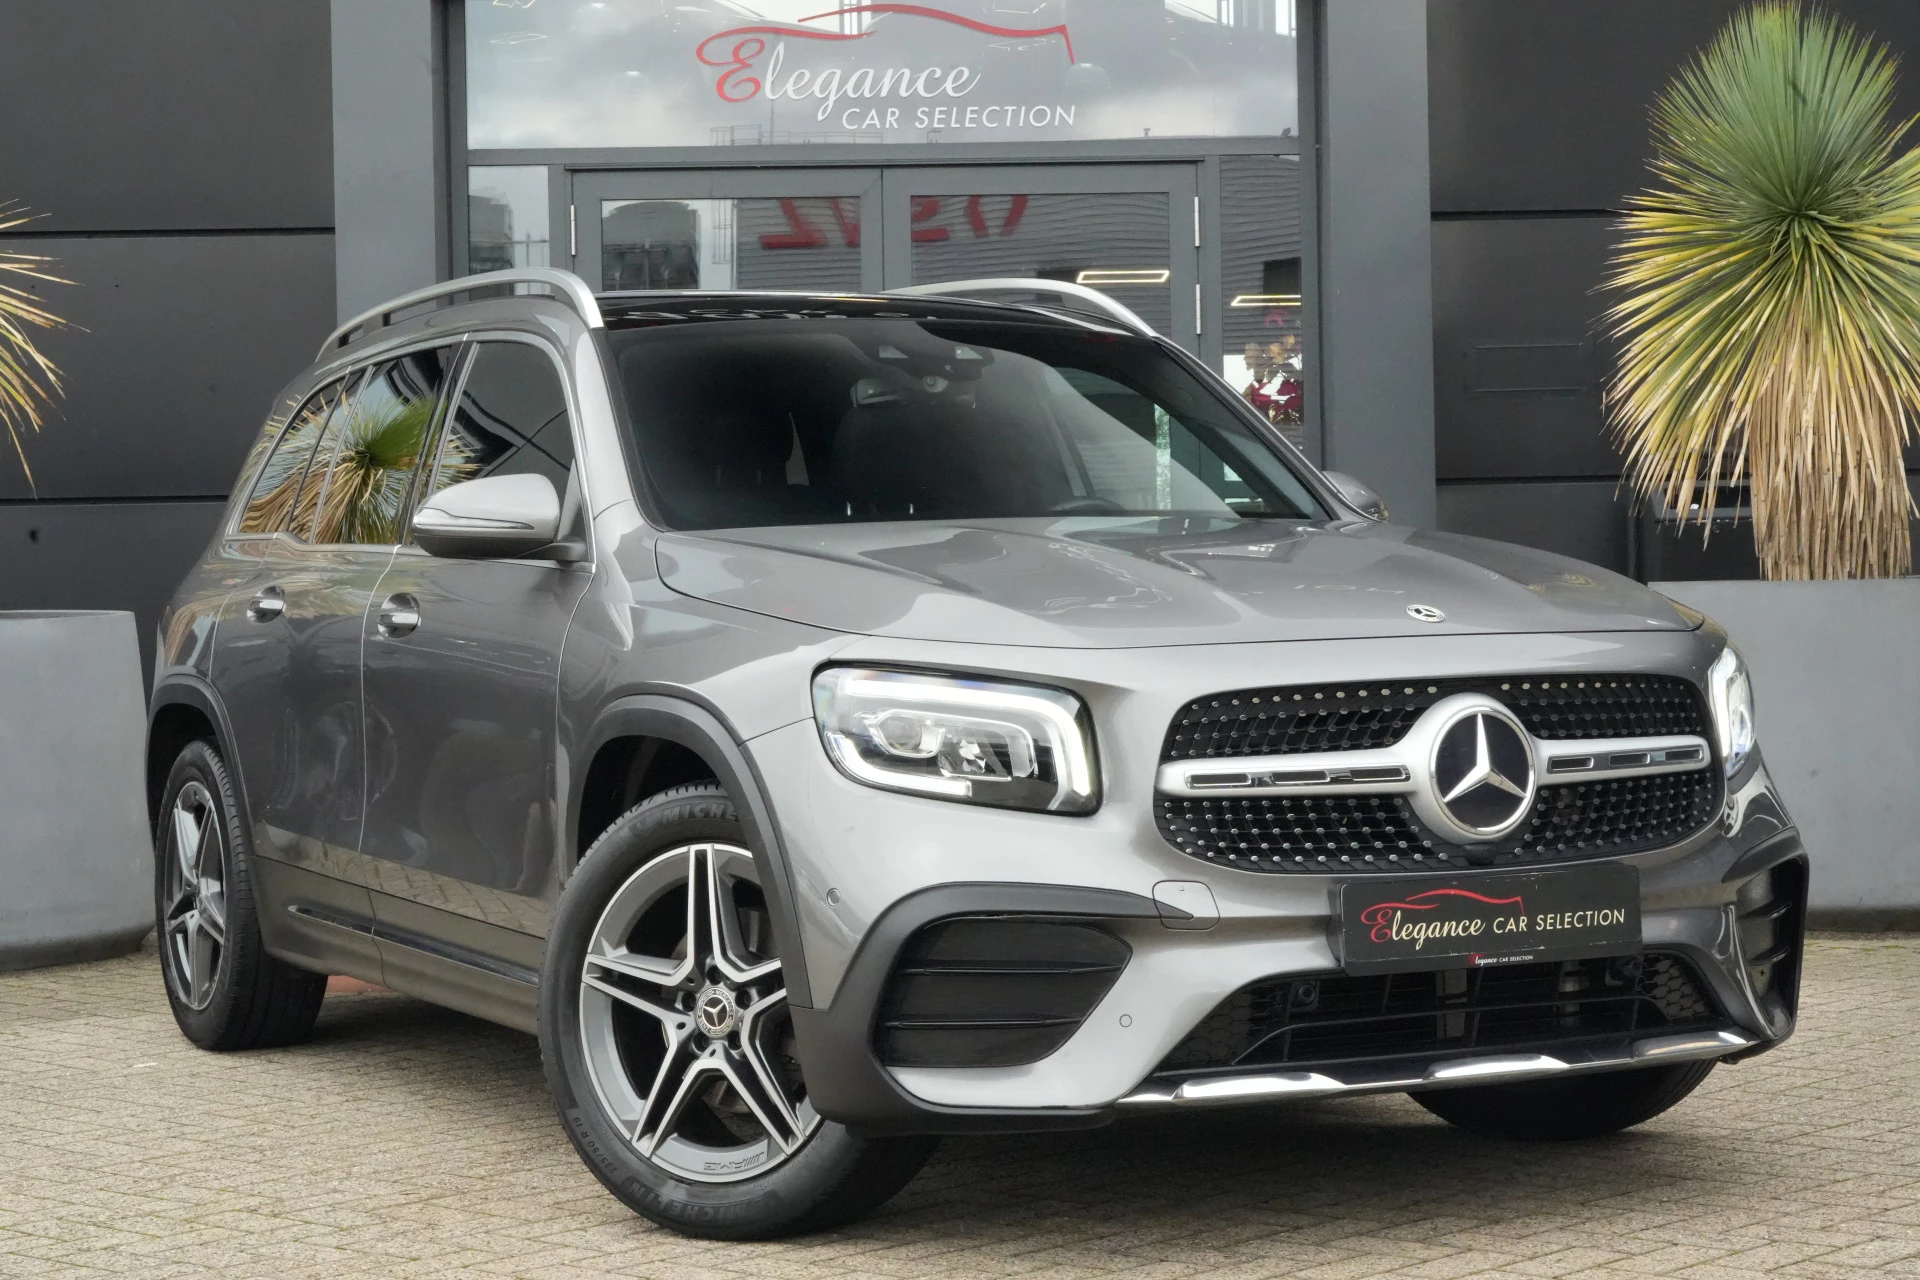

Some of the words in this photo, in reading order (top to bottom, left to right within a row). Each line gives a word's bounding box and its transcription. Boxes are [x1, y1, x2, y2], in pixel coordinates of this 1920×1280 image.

[695, 26, 981, 122] Elegance
[842, 108, 899, 129] CAR
[914, 105, 1076, 128] SELECTION
[660, 802, 739, 824] MICHE
[1360, 903, 1486, 950] Elegance
[1493, 916, 1528, 934] CAR
[1535, 909, 1625, 931] SELECTION
[573, 1116, 583, 1128] 19
[581, 1130, 590, 1139] R
[627, 1181, 743, 1221] MICHELIN
